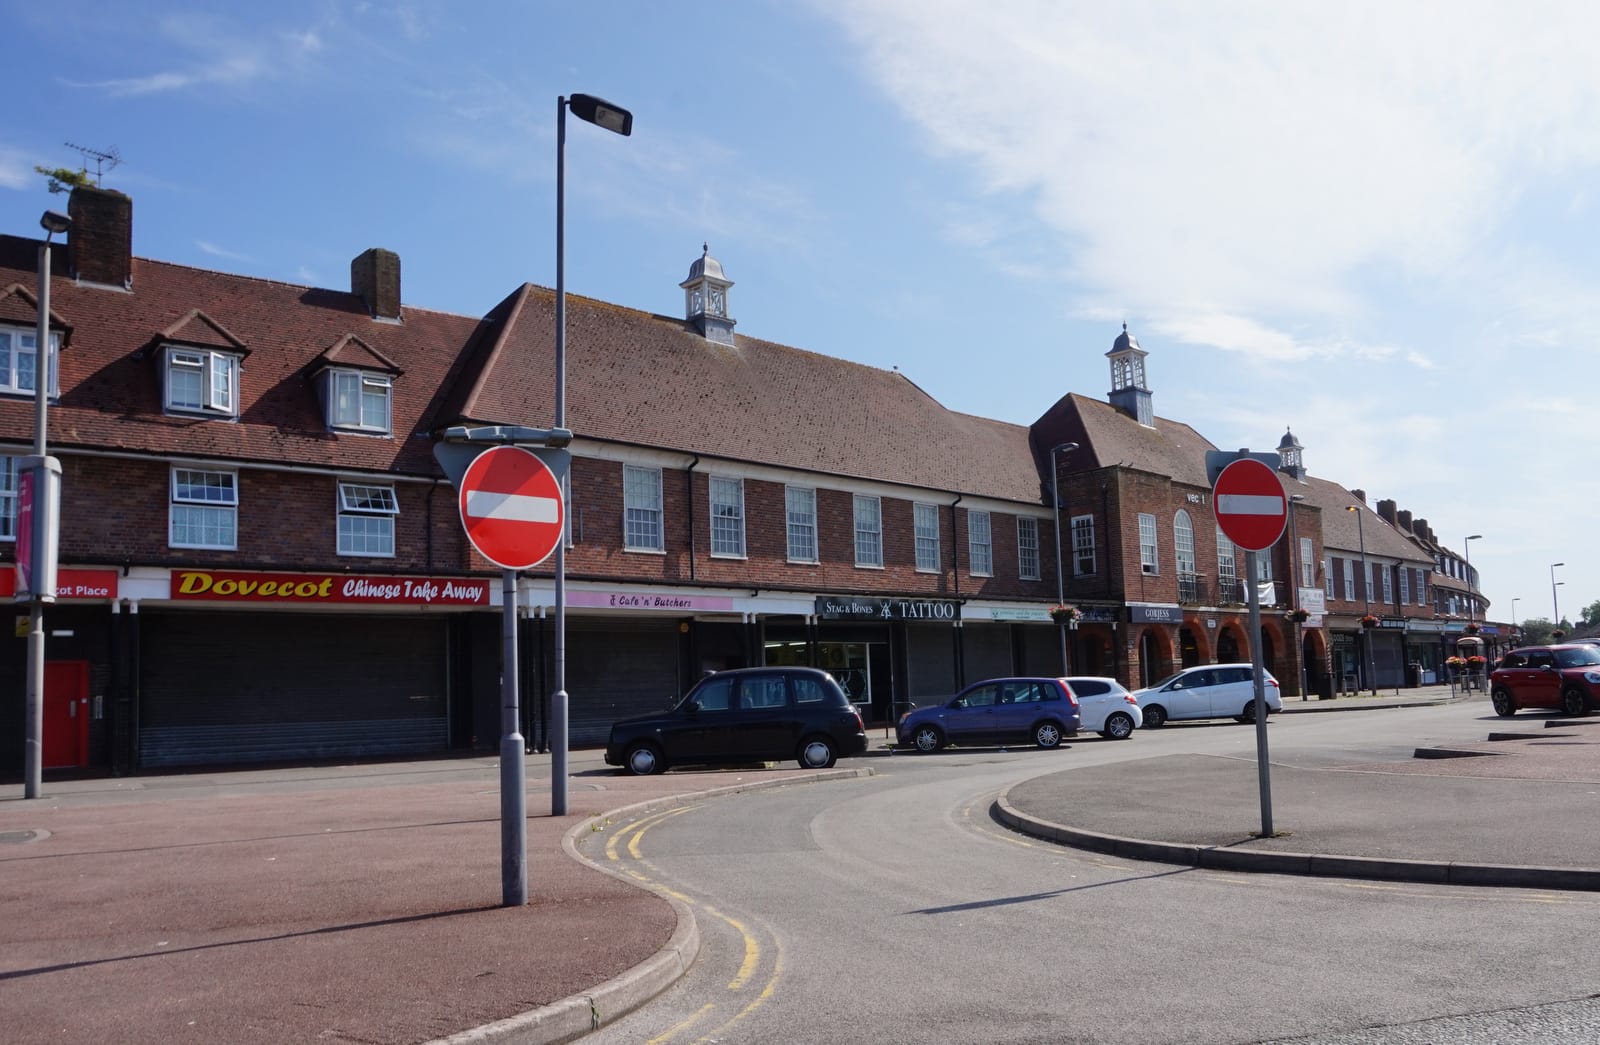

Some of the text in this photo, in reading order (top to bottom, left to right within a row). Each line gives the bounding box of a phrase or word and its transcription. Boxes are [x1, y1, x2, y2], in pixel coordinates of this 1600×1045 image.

[76, 586, 108, 595] Place
[178, 572, 483, 602] Dovecot Chinese Take Away
[619, 595, 639, 606] Cafe
[654, 597, 692, 608] Butchers
[898, 602, 954, 618] TATTOO
